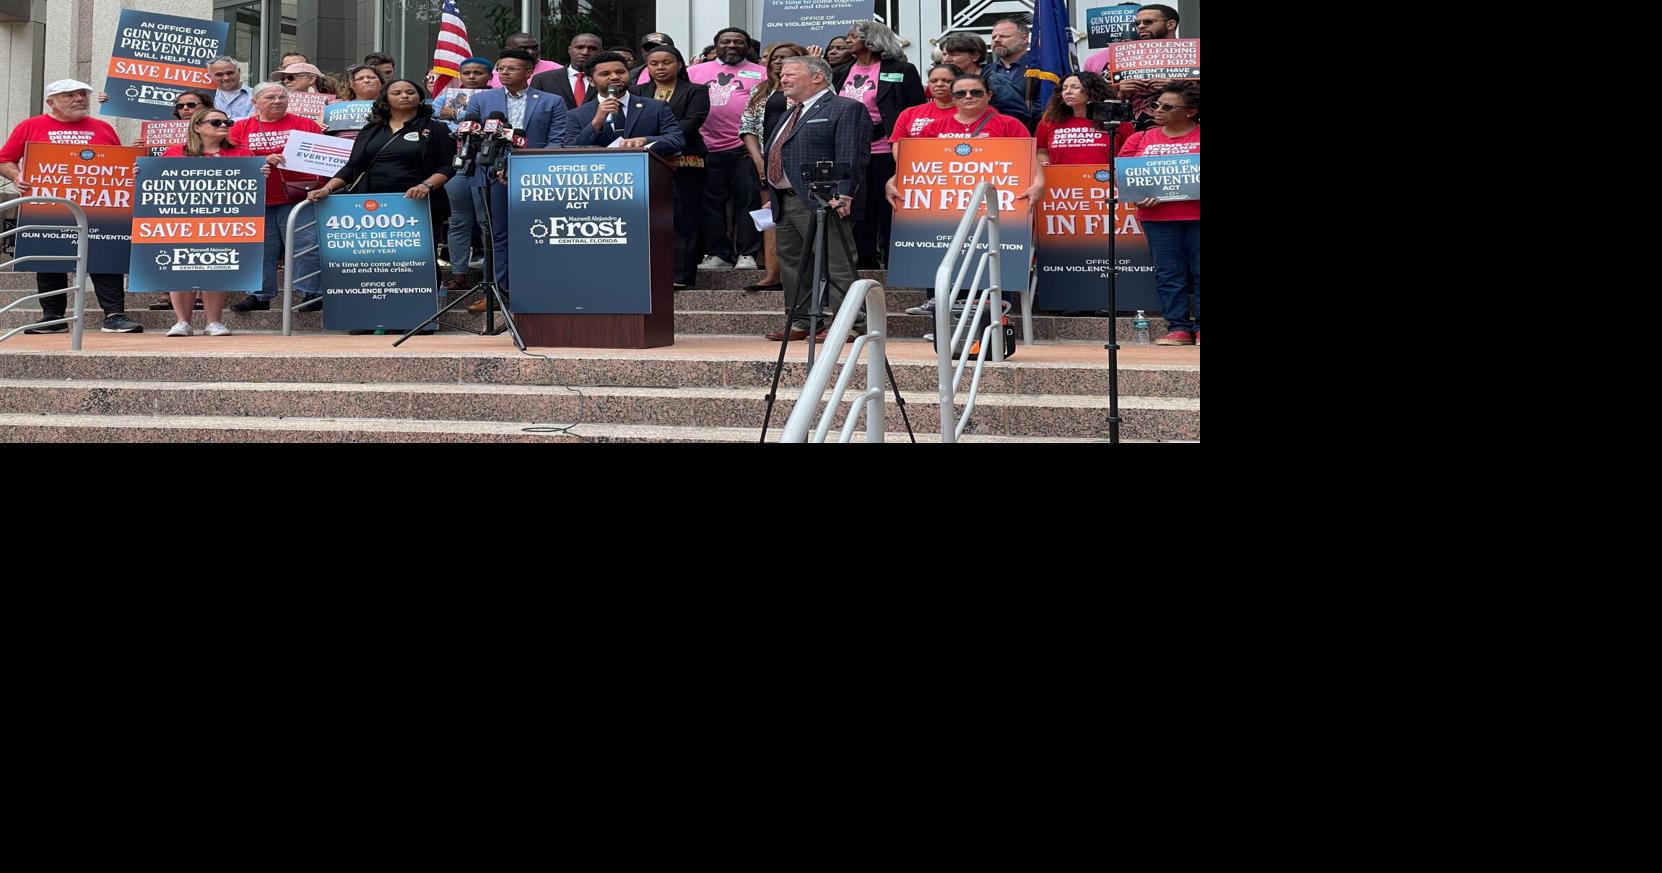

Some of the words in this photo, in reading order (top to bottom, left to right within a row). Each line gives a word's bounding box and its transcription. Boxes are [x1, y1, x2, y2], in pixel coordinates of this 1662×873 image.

[1091, 17, 1104, 26] GUN
[157, 23, 192, 34] OFFICE
[123, 28, 151, 40] GUN
[154, 32, 219, 49] VIOLENCE
[120, 38, 217, 59] PREVENTION
[1115, 44, 1137, 52] GUN
[1139, 41, 1197, 49] VIOLENCE
[134, 51, 158, 60] WILL
[160, 55, 186, 63] HELP
[1116, 61, 1137, 70] FOR
[115, 61, 160, 79] SAVE
[163, 67, 212, 85] LIVES
[249, 135, 289, 143] DEMAND
[517, 137, 525, 146] 9
[297, 152, 348, 164] EVERYTOW
[39, 163, 68, 174] WE
[74, 165, 129, 176] DON'T
[912, 162, 943, 174] WE
[949, 161, 1013, 174] DON'T
[1126, 168, 1150, 177] GUN
[1153, 165, 1200, 176] VIOLEN
[31, 175, 72, 185] HAVE
[77, 176, 97, 185] TO
[102, 178, 134, 187] LIVE
[142, 180, 178, 191] GUN
[180, 179, 257, 191] VIOLENCE
[521, 174, 552, 187] GUN
[556, 173, 634, 186] VIOLENCE
[903, 176, 948, 186] HAVE
[953, 176, 976, 186] TO
[142, 192, 257, 206] PREVENTION
[521, 187, 634, 202] PREVENTION
[903, 189, 932, 210] IN
[1050, 188, 1084, 200] WE
[1043, 201, 1090, 211] HAVE
[326, 214, 419, 231] 40,000+
[550, 217, 627, 237] Frost
[1046, 215, 1076, 235] IN
[140, 222, 193, 238] SAVE
[198, 222, 257, 238] LIVES
[328, 240, 354, 249] GUN
[358, 239, 421, 248] VIOLENCE
[173, 248, 240, 265] Frost
